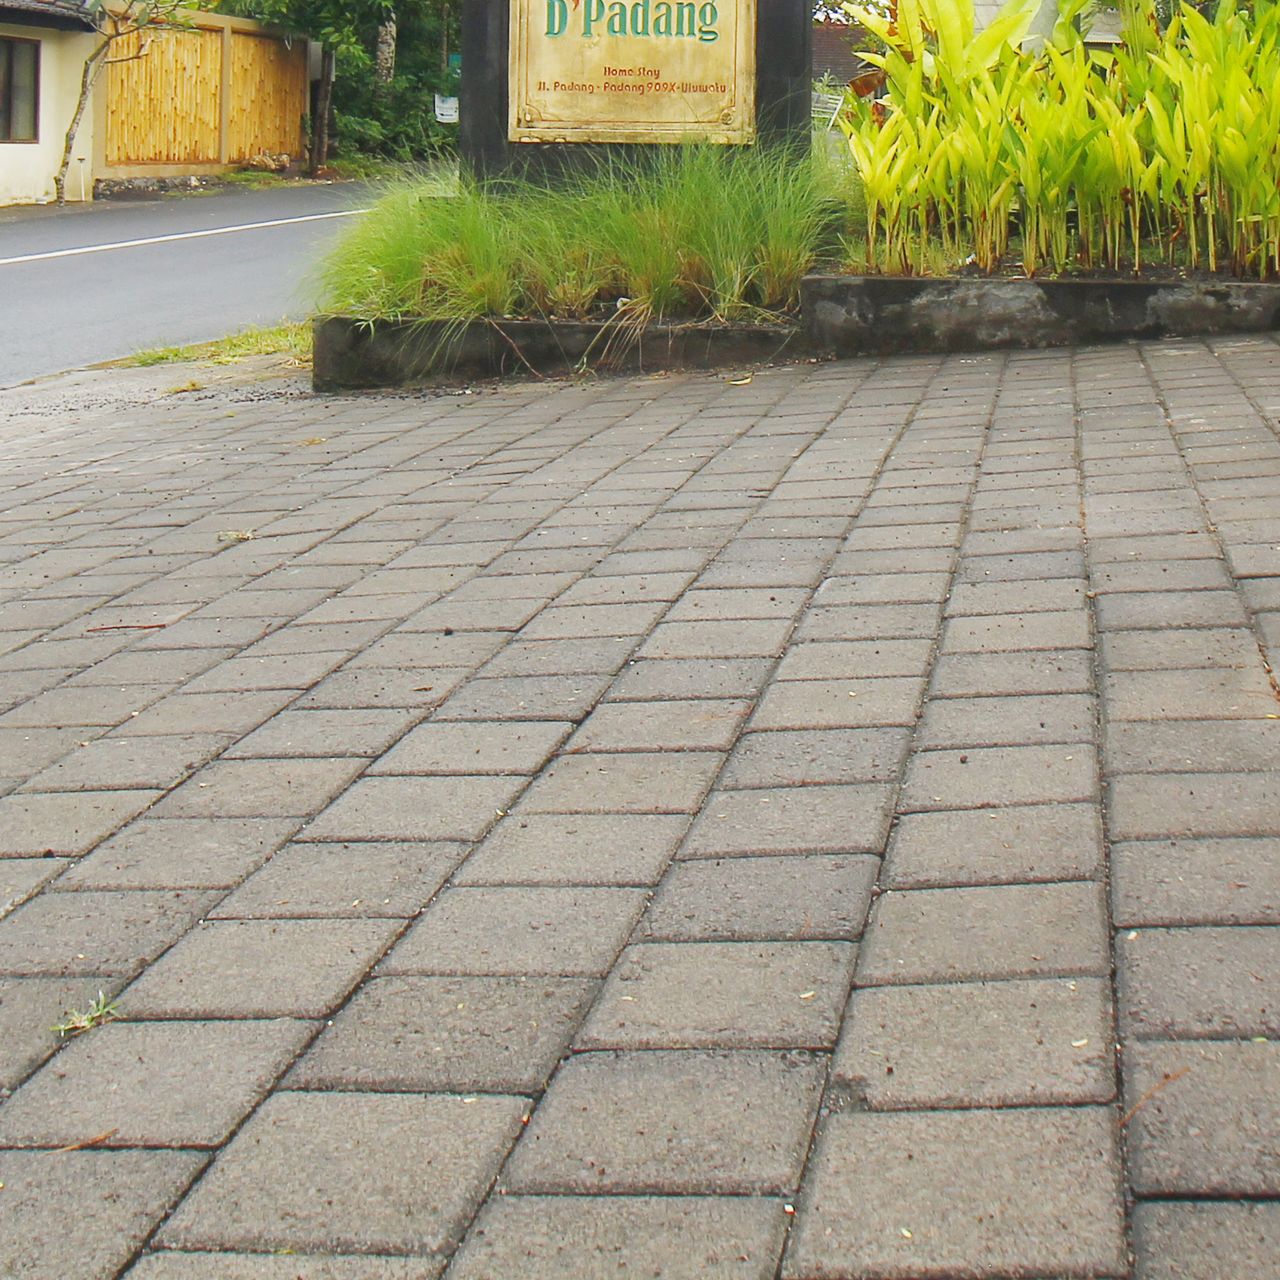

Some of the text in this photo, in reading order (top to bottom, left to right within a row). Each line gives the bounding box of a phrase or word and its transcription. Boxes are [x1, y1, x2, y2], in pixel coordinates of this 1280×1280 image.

[603, 67, 660, 80] Home Stay
[553, 82, 594, 94] Padang
[603, 82, 645, 95] Padang
